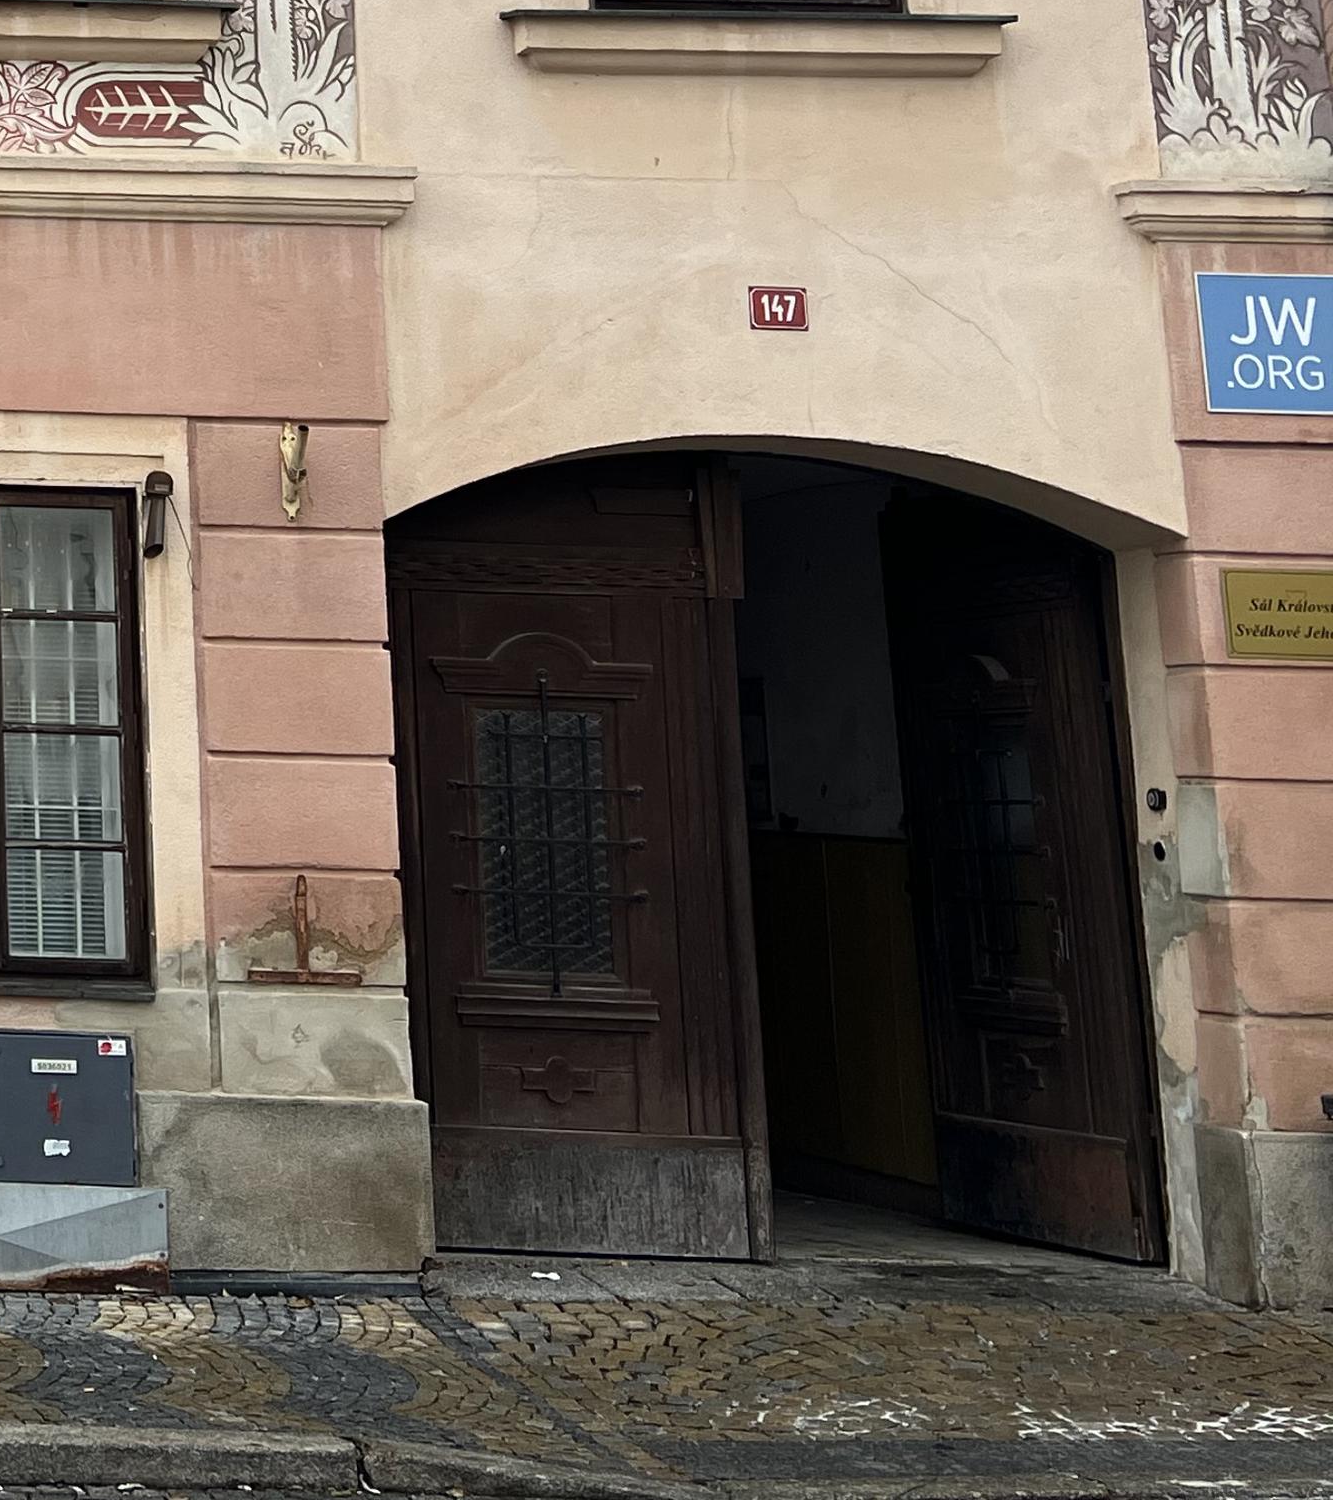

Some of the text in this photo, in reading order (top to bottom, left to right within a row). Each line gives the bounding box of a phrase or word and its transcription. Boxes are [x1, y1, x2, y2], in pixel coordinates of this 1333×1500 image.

[761, 294, 796, 322] 147
[1230, 295, 1316, 346] JW
[1226, 354, 1325, 391] .ORG
[1249, 598, 1273, 612] Sál
[1235, 623, 1301, 639] Svědkové
